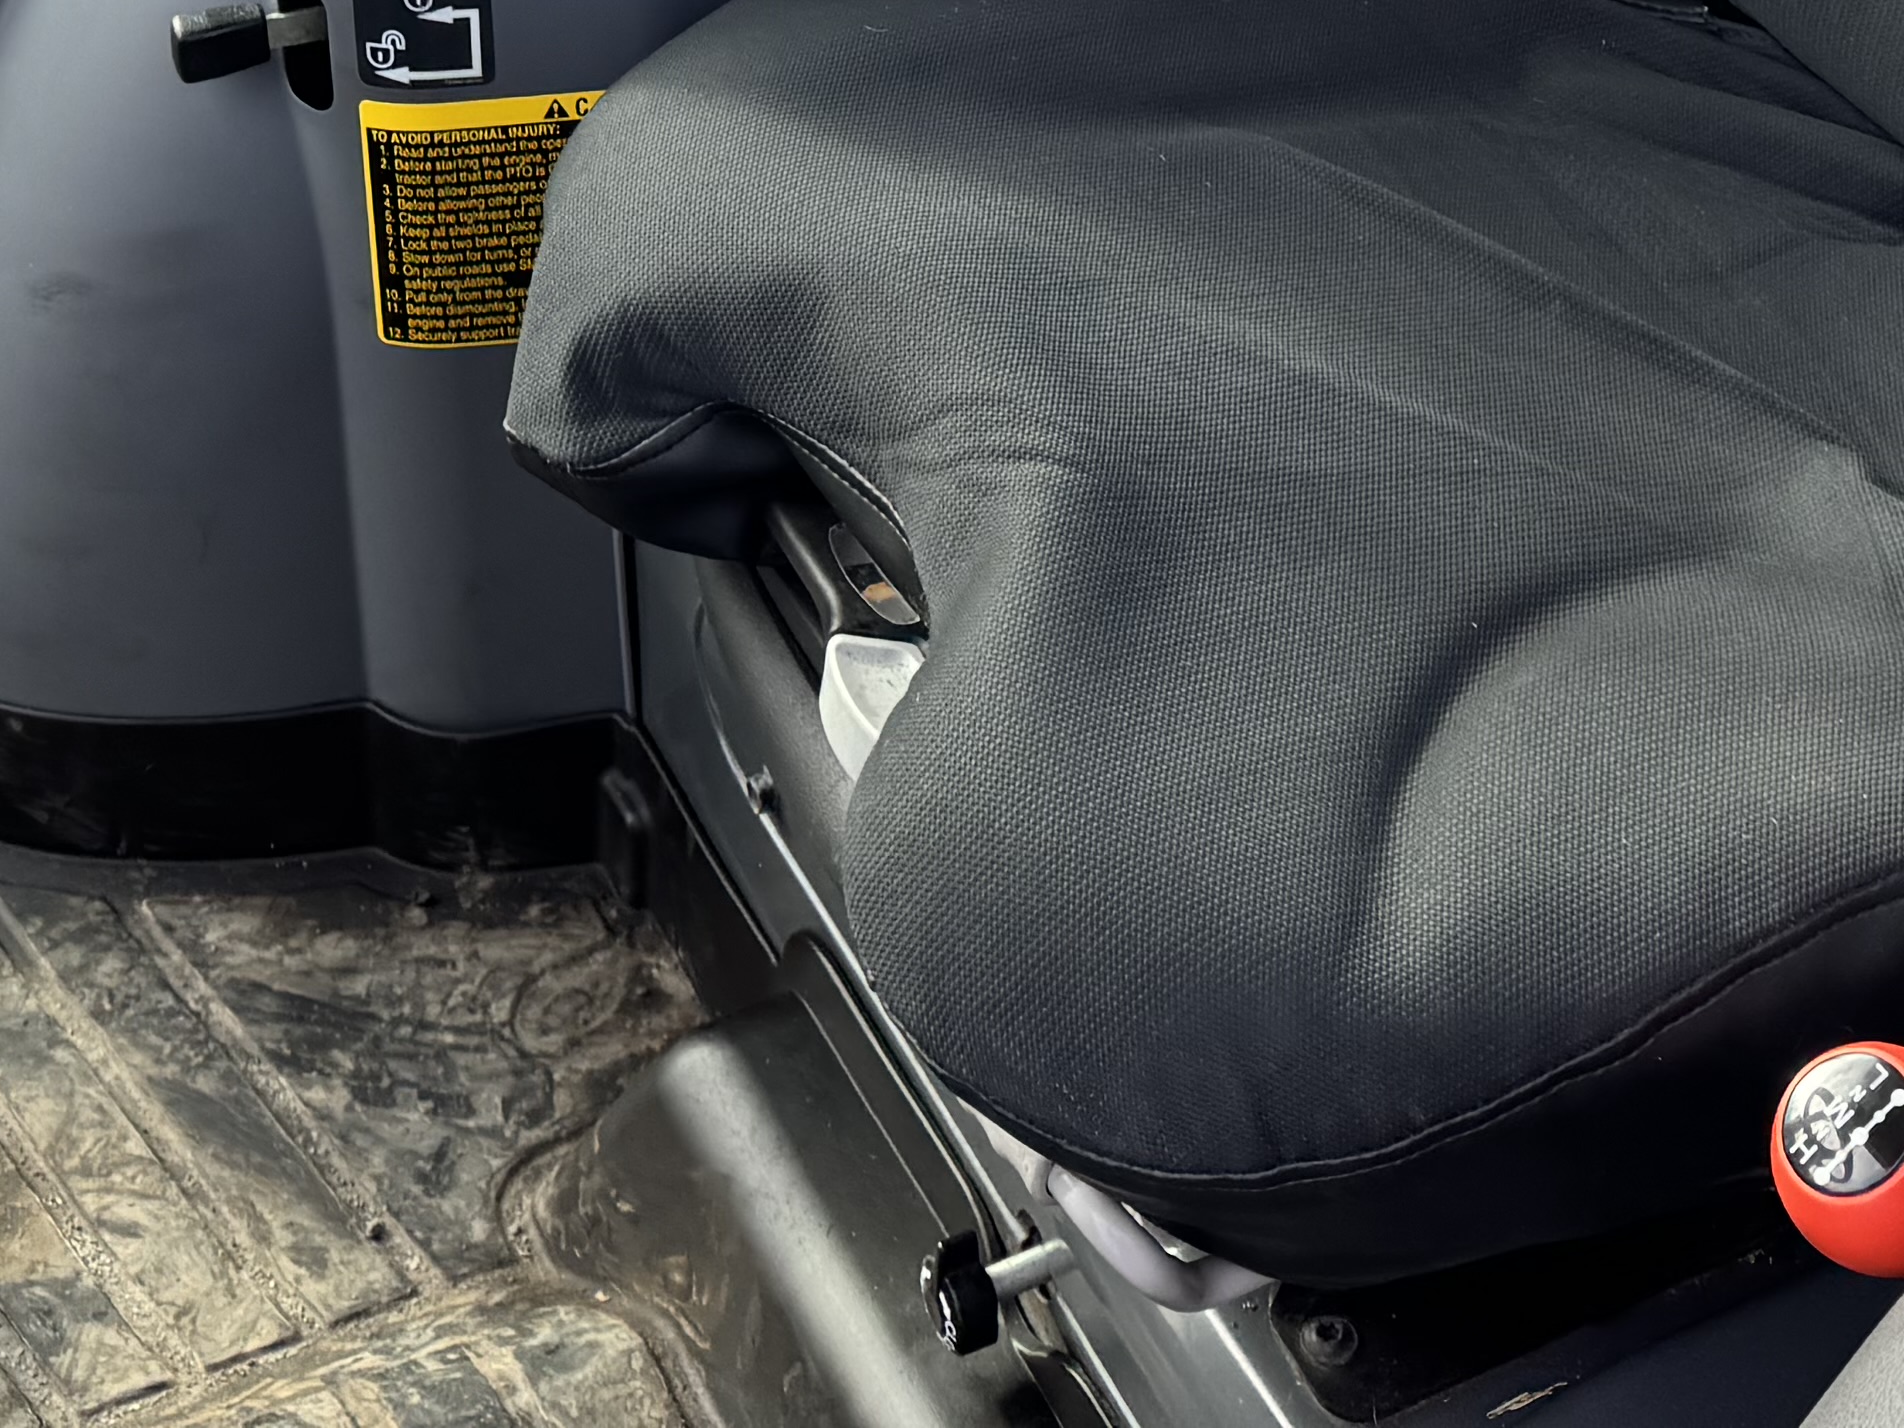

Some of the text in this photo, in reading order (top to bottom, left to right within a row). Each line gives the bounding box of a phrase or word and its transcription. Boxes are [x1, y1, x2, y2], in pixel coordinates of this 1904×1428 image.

[371, 124, 560, 145] TO AVOID PERSONAL INJURY:
[394, 145, 424, 158] Read
[427, 144, 449, 158] and
[452, 139, 517, 156] understand
[520, 139, 538, 150] the
[395, 158, 432, 171] Before
[435, 155, 479, 172] starting
[482, 154, 501, 167] the
[504, 152, 546, 169] engine,
[395, 171, 431, 185] tractor
[435, 169, 457, 183] and
[459, 169, 481, 183] that
[484, 168, 502, 180] the
[506, 166, 533, 178] PTO
[536, 166, 546, 176] is
[383, 185, 392, 196] 3.
[397, 185, 413, 197] Do
[417, 186, 434, 198] not
[437, 184, 467, 197] allow
[470, 180, 537, 197] passengers
[384, 198, 394, 209] 4.
[398, 198, 435, 211] Before
[438, 197, 485, 211] allowing
[488, 193, 517, 206] other
[385, 205, 541, 225] 5. Check the tightness of all
[400, 224, 429, 239] Keep
[432, 226, 445, 237] all
[449, 222, 489, 236] shields
[492, 221, 503, 233] in
[506, 219, 537, 234] place
[386, 235, 508, 251] 7. Lock the two brake
[402, 247, 531, 264] Slow down for turns, or
[389, 263, 399, 275] 9.
[403, 264, 420, 277] On
[422, 263, 457, 278] public
[459, 261, 492, 275] roads
[495, 261, 516, 272] use
[404, 275, 507, 292] safety regulations.
[386, 288, 401, 301] 10.
[406, 291, 427, 303] Pull
[429, 291, 453, 304] only
[456, 289, 482, 301] from
[485, 287, 503, 299] the
[387, 301, 402, 314] 11.
[406, 303, 444, 316] Before
[446, 300, 518, 315] dismounting,
[408, 313, 515, 330] engine and remove
[389, 327, 404, 339] 12.
[408, 327, 457, 343] Securely
[460, 325, 505, 340] support
